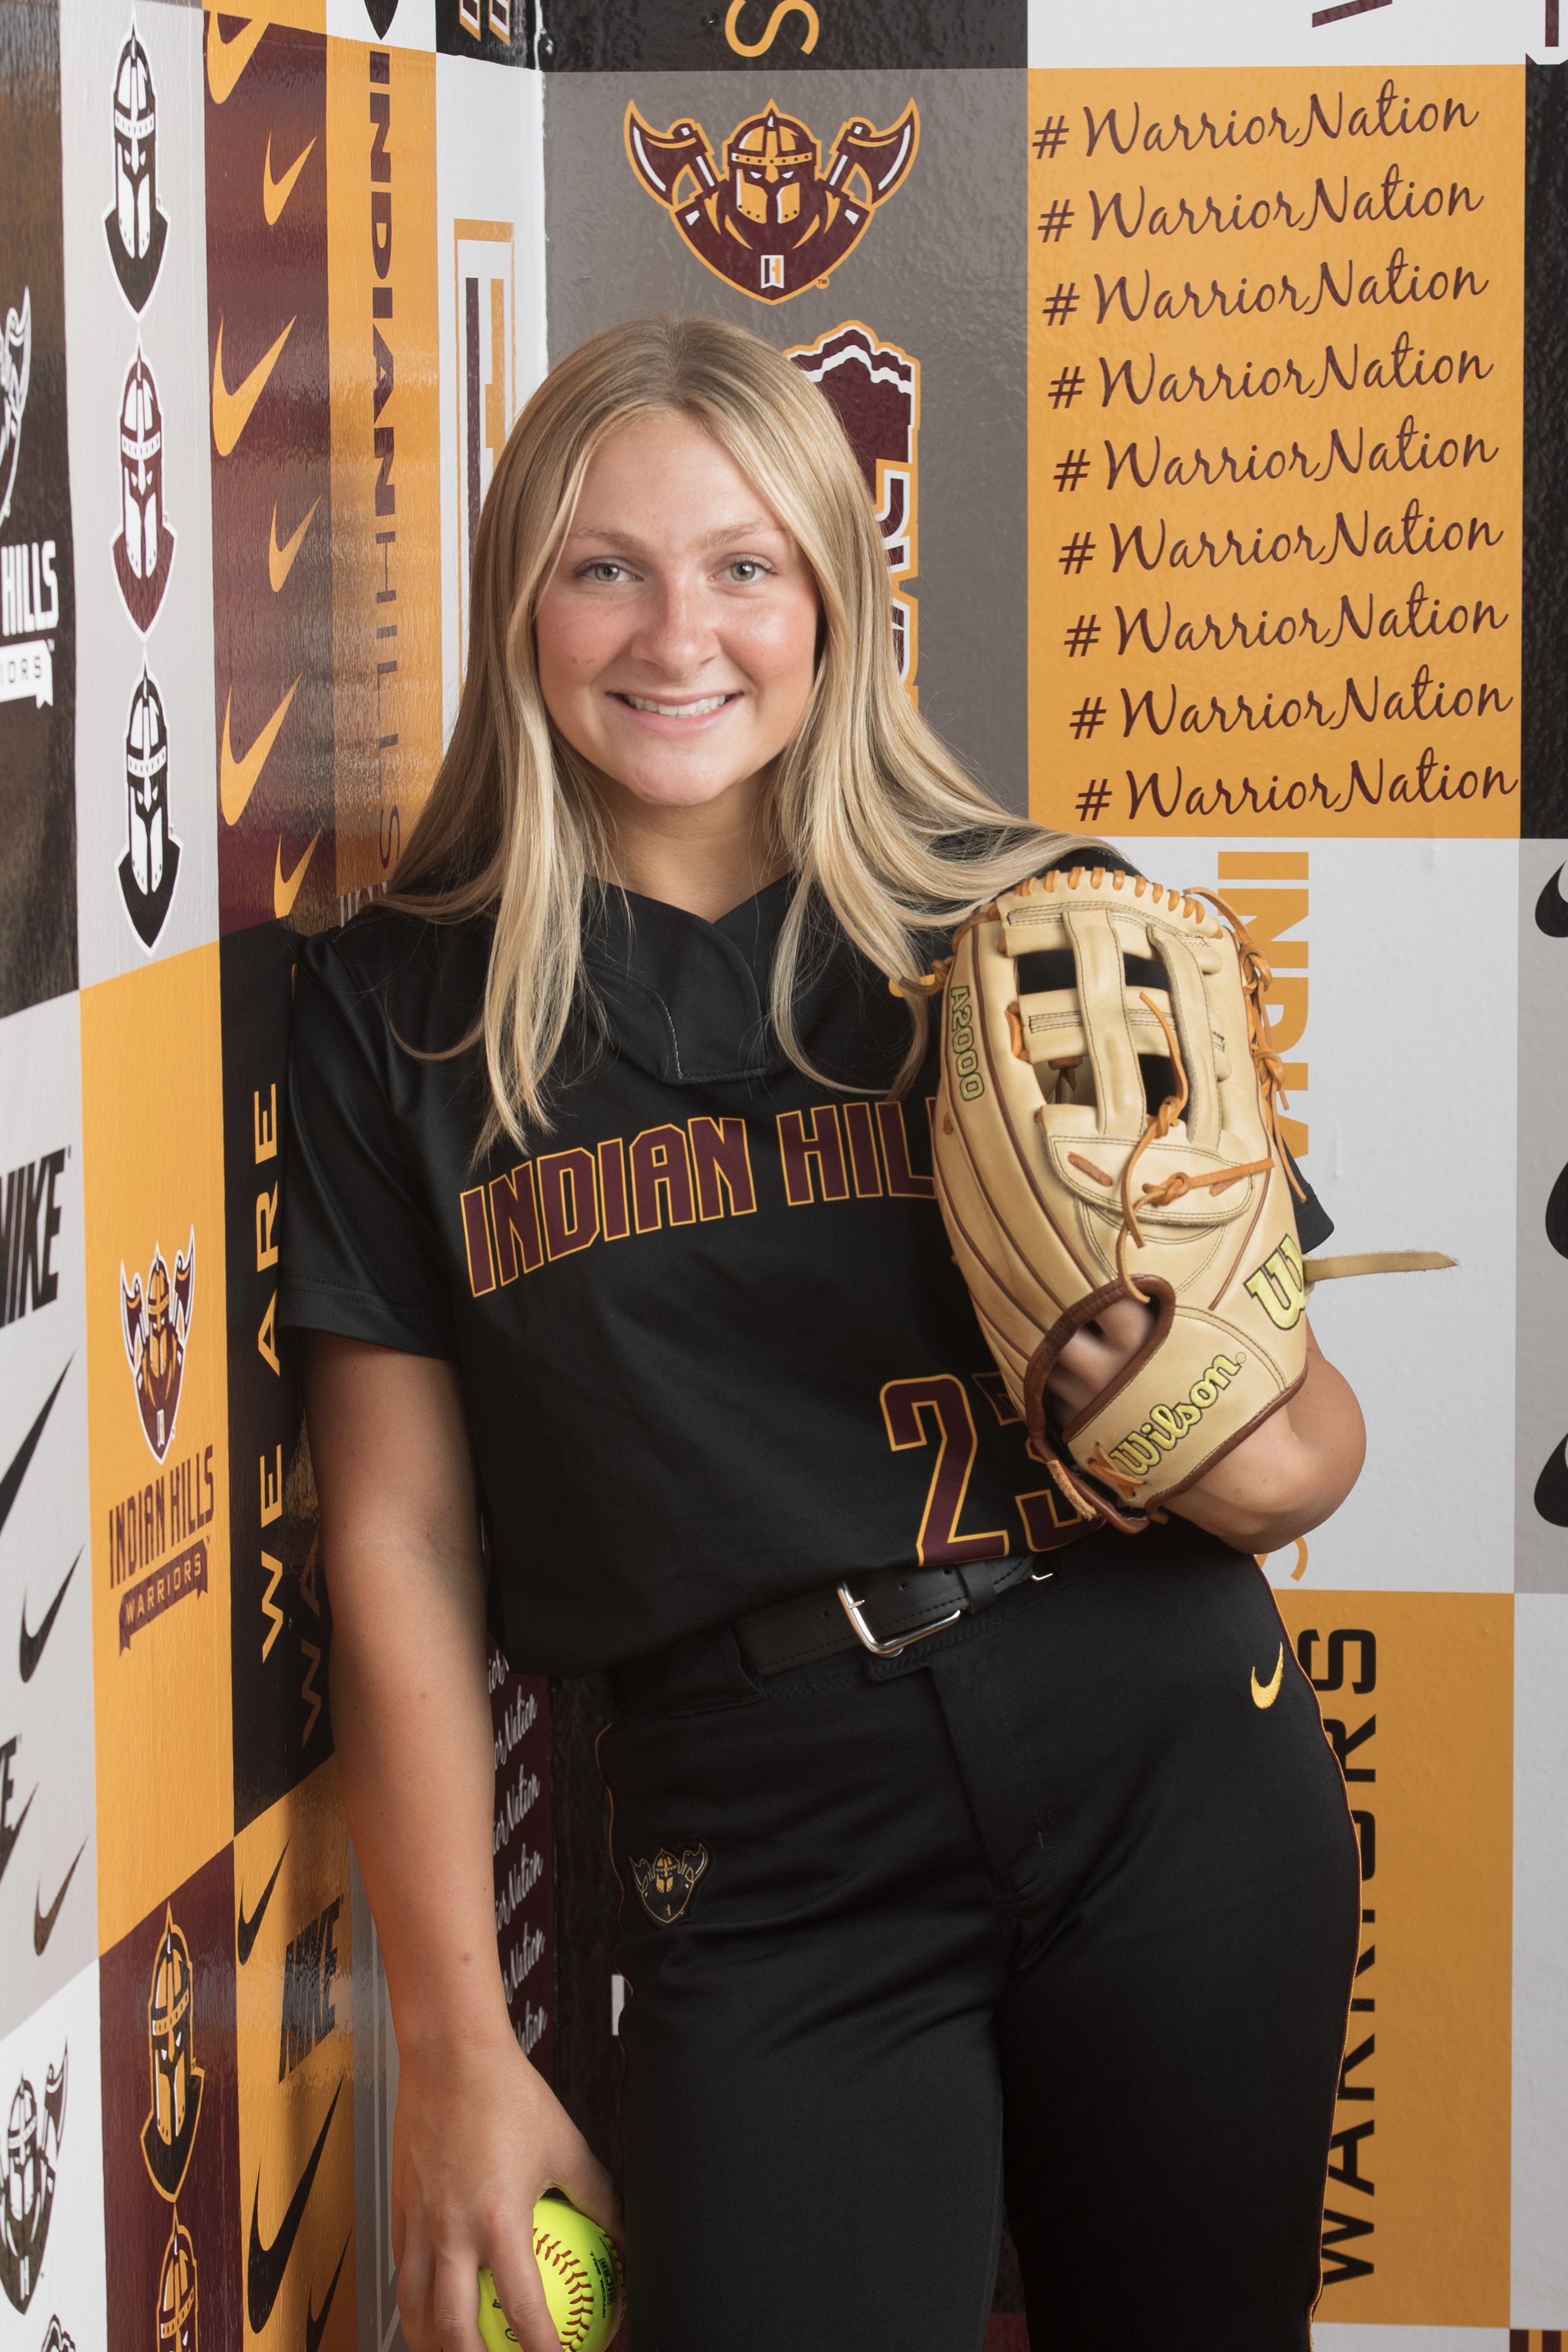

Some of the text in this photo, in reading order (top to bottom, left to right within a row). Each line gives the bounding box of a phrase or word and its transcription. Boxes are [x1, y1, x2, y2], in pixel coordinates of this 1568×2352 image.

[369, 50, 396, 517] INDIAN
[1, 540, 59, 637] HILLS
[951, 985, 985, 1101] A2000
[460, 1097, 937, 1298] INDIAN HIL
[254, 1083, 283, 1663] WE ARE
[1109, 1354, 1242, 1476] Wilson
[109, 1444, 214, 1590] INDIAN HILLS
[126, 1552, 202, 1625] WARRIORS
[278, 1896, 340, 2083] NIKE
